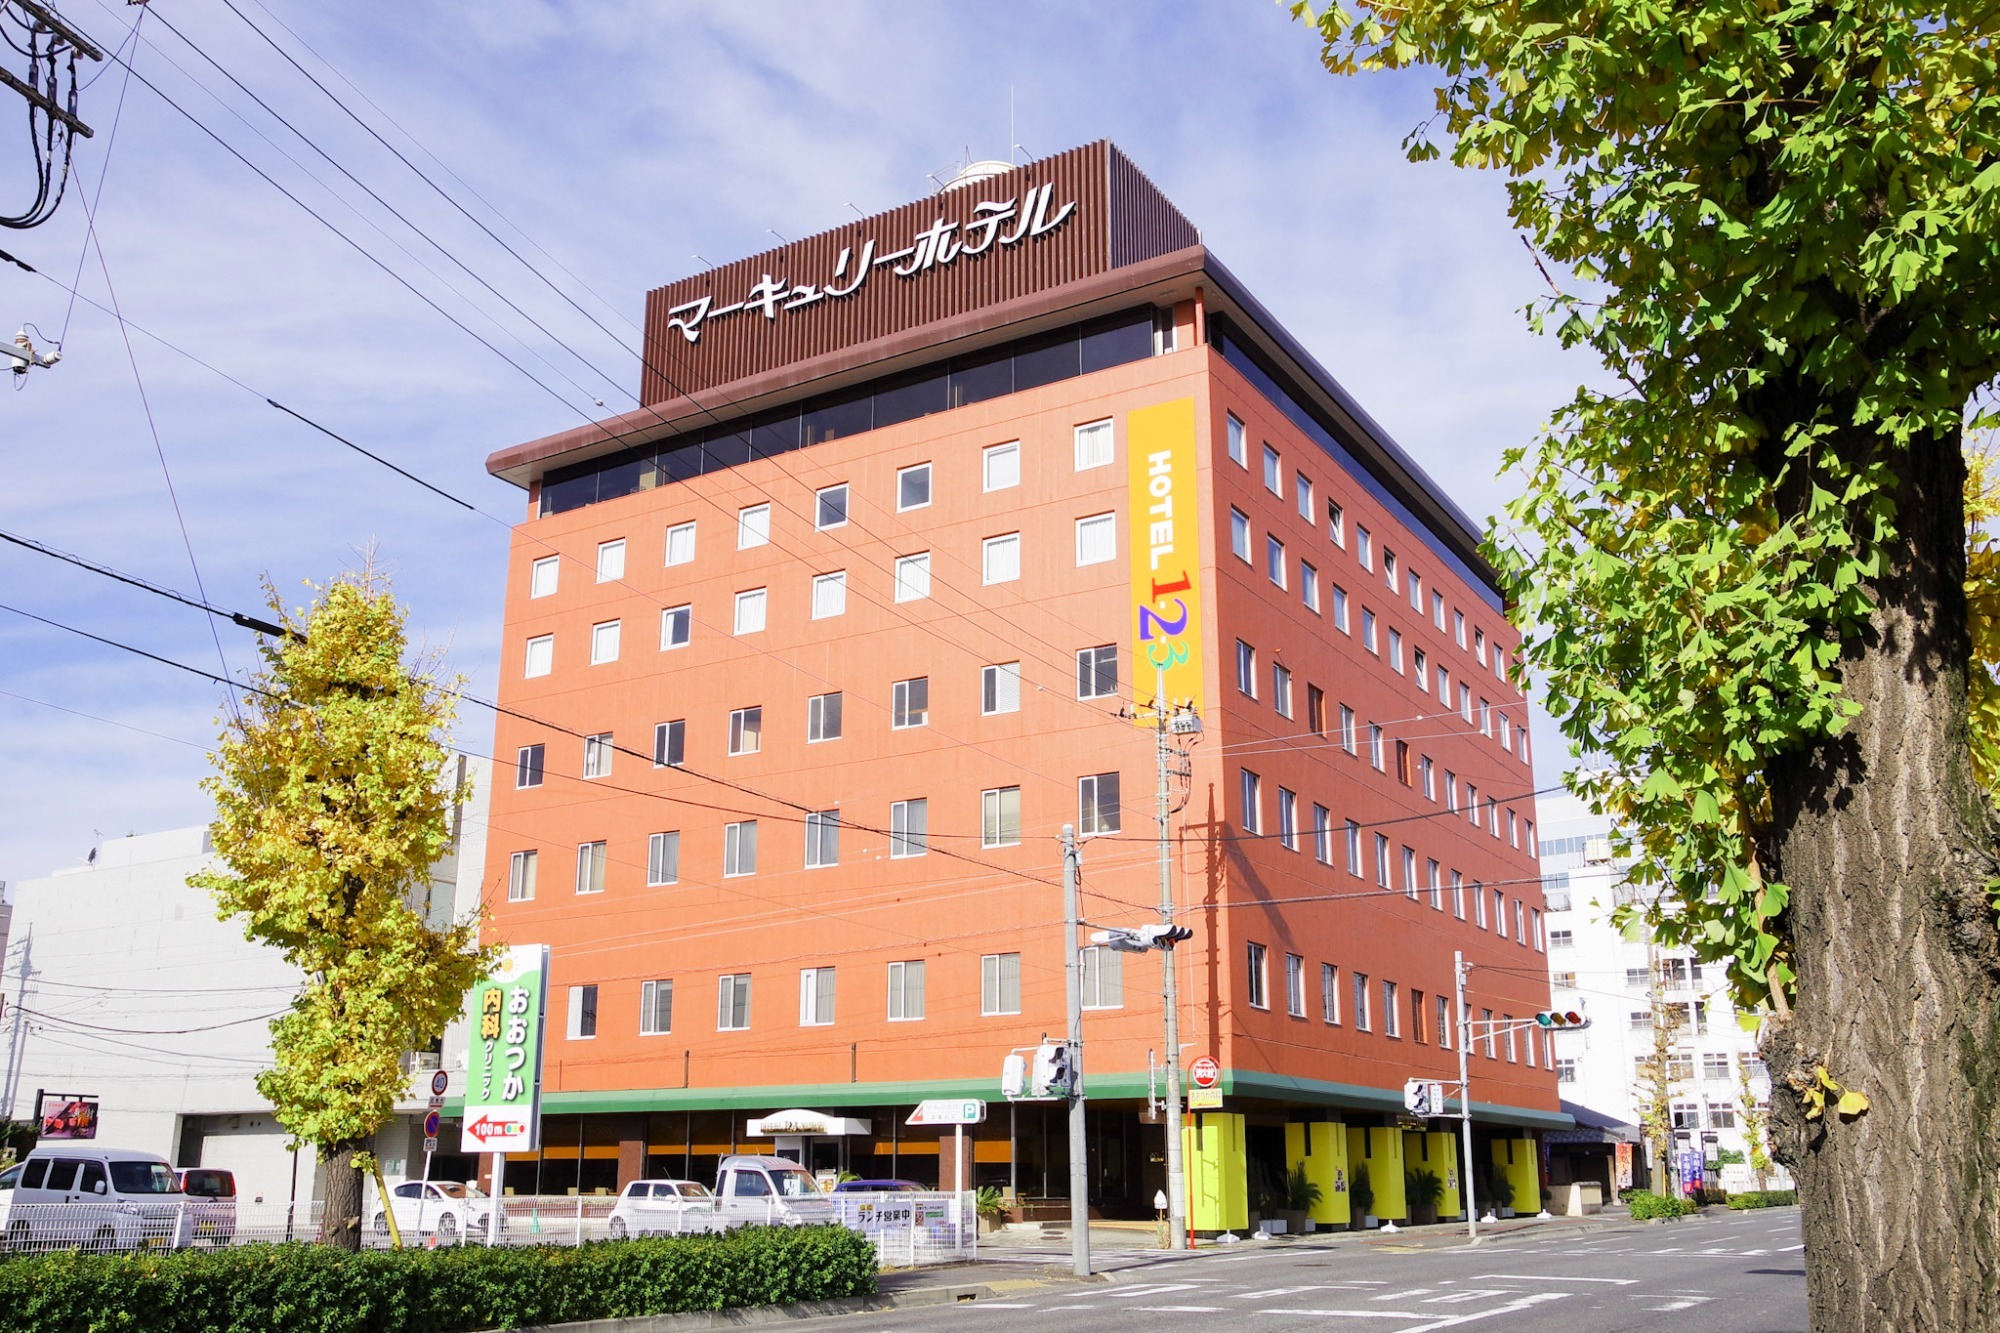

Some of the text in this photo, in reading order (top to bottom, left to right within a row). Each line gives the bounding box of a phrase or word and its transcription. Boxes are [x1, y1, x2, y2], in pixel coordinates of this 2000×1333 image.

[667, 183, 1076, 343] マーキュリーホテル
[1148, 450, 1173, 569] HOTEL
[502, 985, 530, 1100] おおつか
[435, 1077, 445, 1089] 40
[964, 1104, 975, 1118] P
[475, 1122, 503, 1136] 100m
[858, 1199, 910, 1223] ランチ営業中
